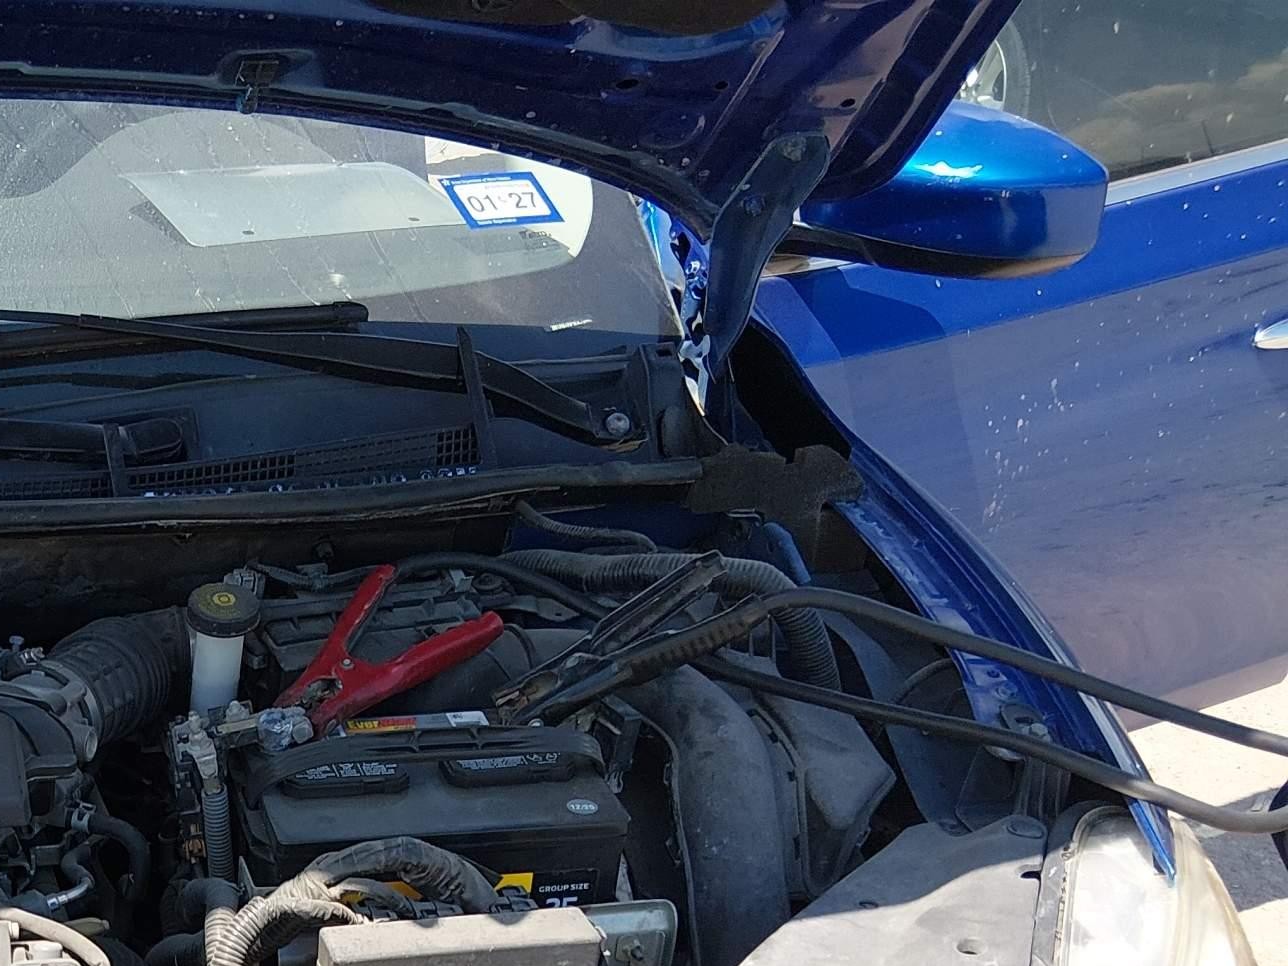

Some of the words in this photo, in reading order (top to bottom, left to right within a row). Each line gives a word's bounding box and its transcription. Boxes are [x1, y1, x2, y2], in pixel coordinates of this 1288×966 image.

[467, 194, 498, 213] 01
[508, 191, 536, 209] 27
[538, 884, 569, 893] GROUP
[570, 882, 590, 890] SIZE
